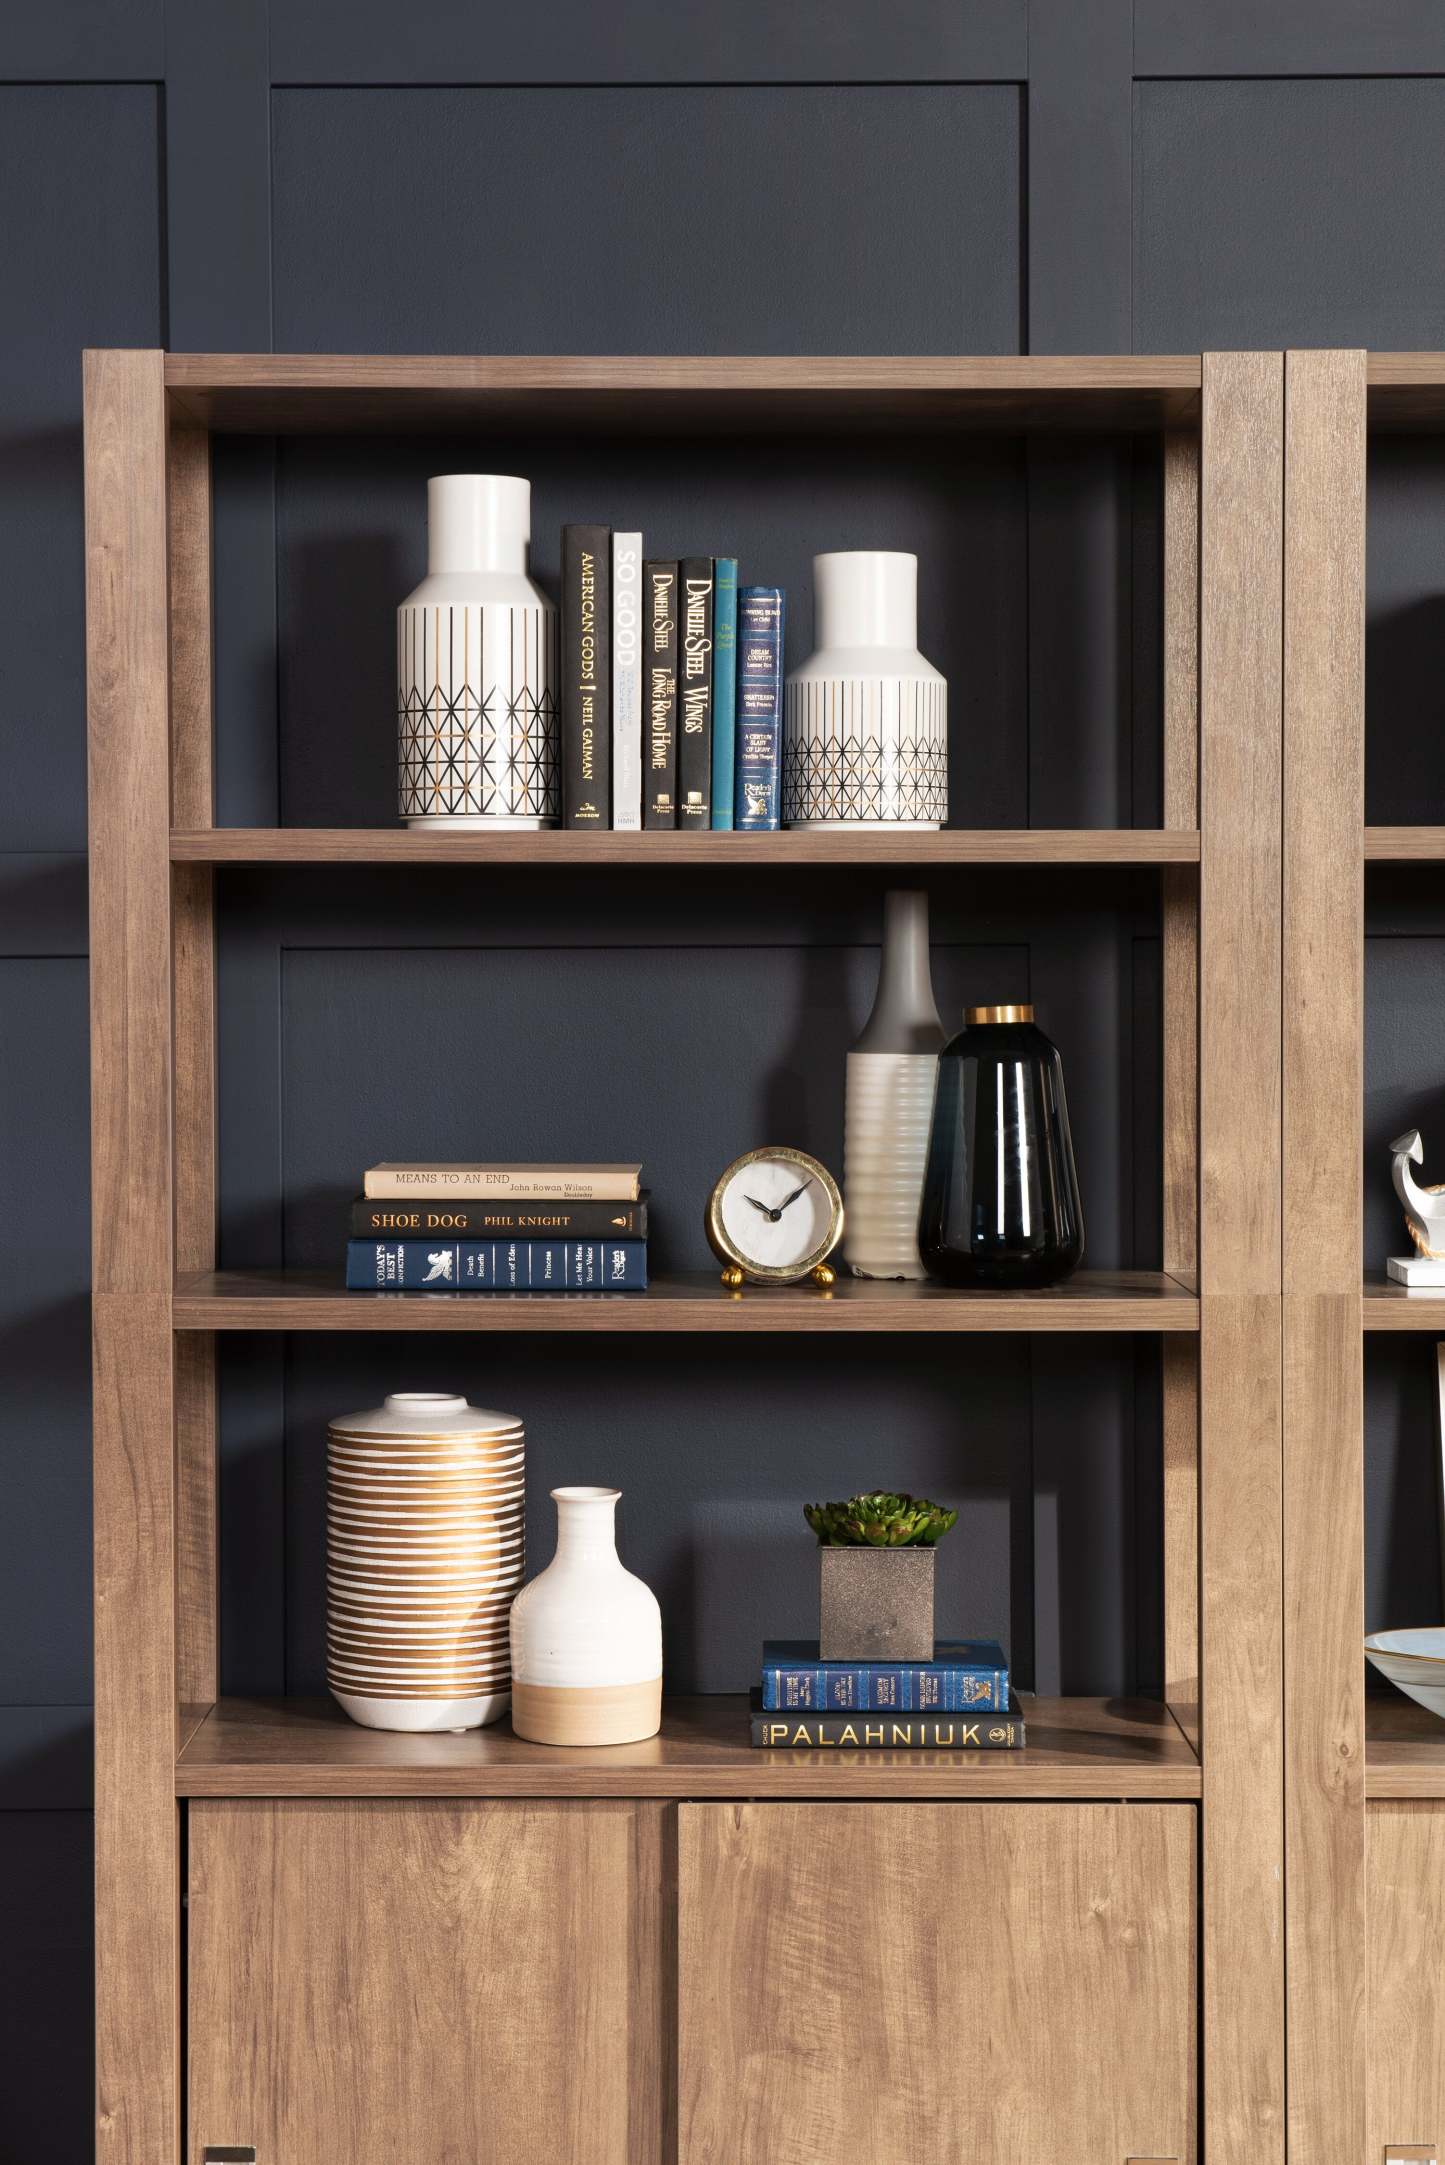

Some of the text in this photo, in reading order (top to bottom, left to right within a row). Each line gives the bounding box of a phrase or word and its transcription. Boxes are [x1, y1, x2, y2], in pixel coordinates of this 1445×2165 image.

[617, 550, 636, 582] SO
[581, 552, 594, 680] AMERICAN GODS
[617, 590, 636, 666] GOOD
[667, 679, 676, 695] THE
[651, 668, 672, 769] LONG ROAD HOME
[683, 686, 709, 733] WINGS
[582, 696, 593, 780] NEIL GAIMAN
[395, 1174, 510, 1184] MEANS TO AN END
[510, 1184, 593, 1192] John Rowan Wilson
[371, 1214, 571, 1228] SHOE DOG PHIL KNIGHT
[508, 1244, 516, 1262] Eden
[386, 1252, 396, 1280] BEST
[508, 1262, 516, 1271] of
[576, 1262, 583, 1275] Me
[770, 1724, 981, 1745] PALAHNIUK
